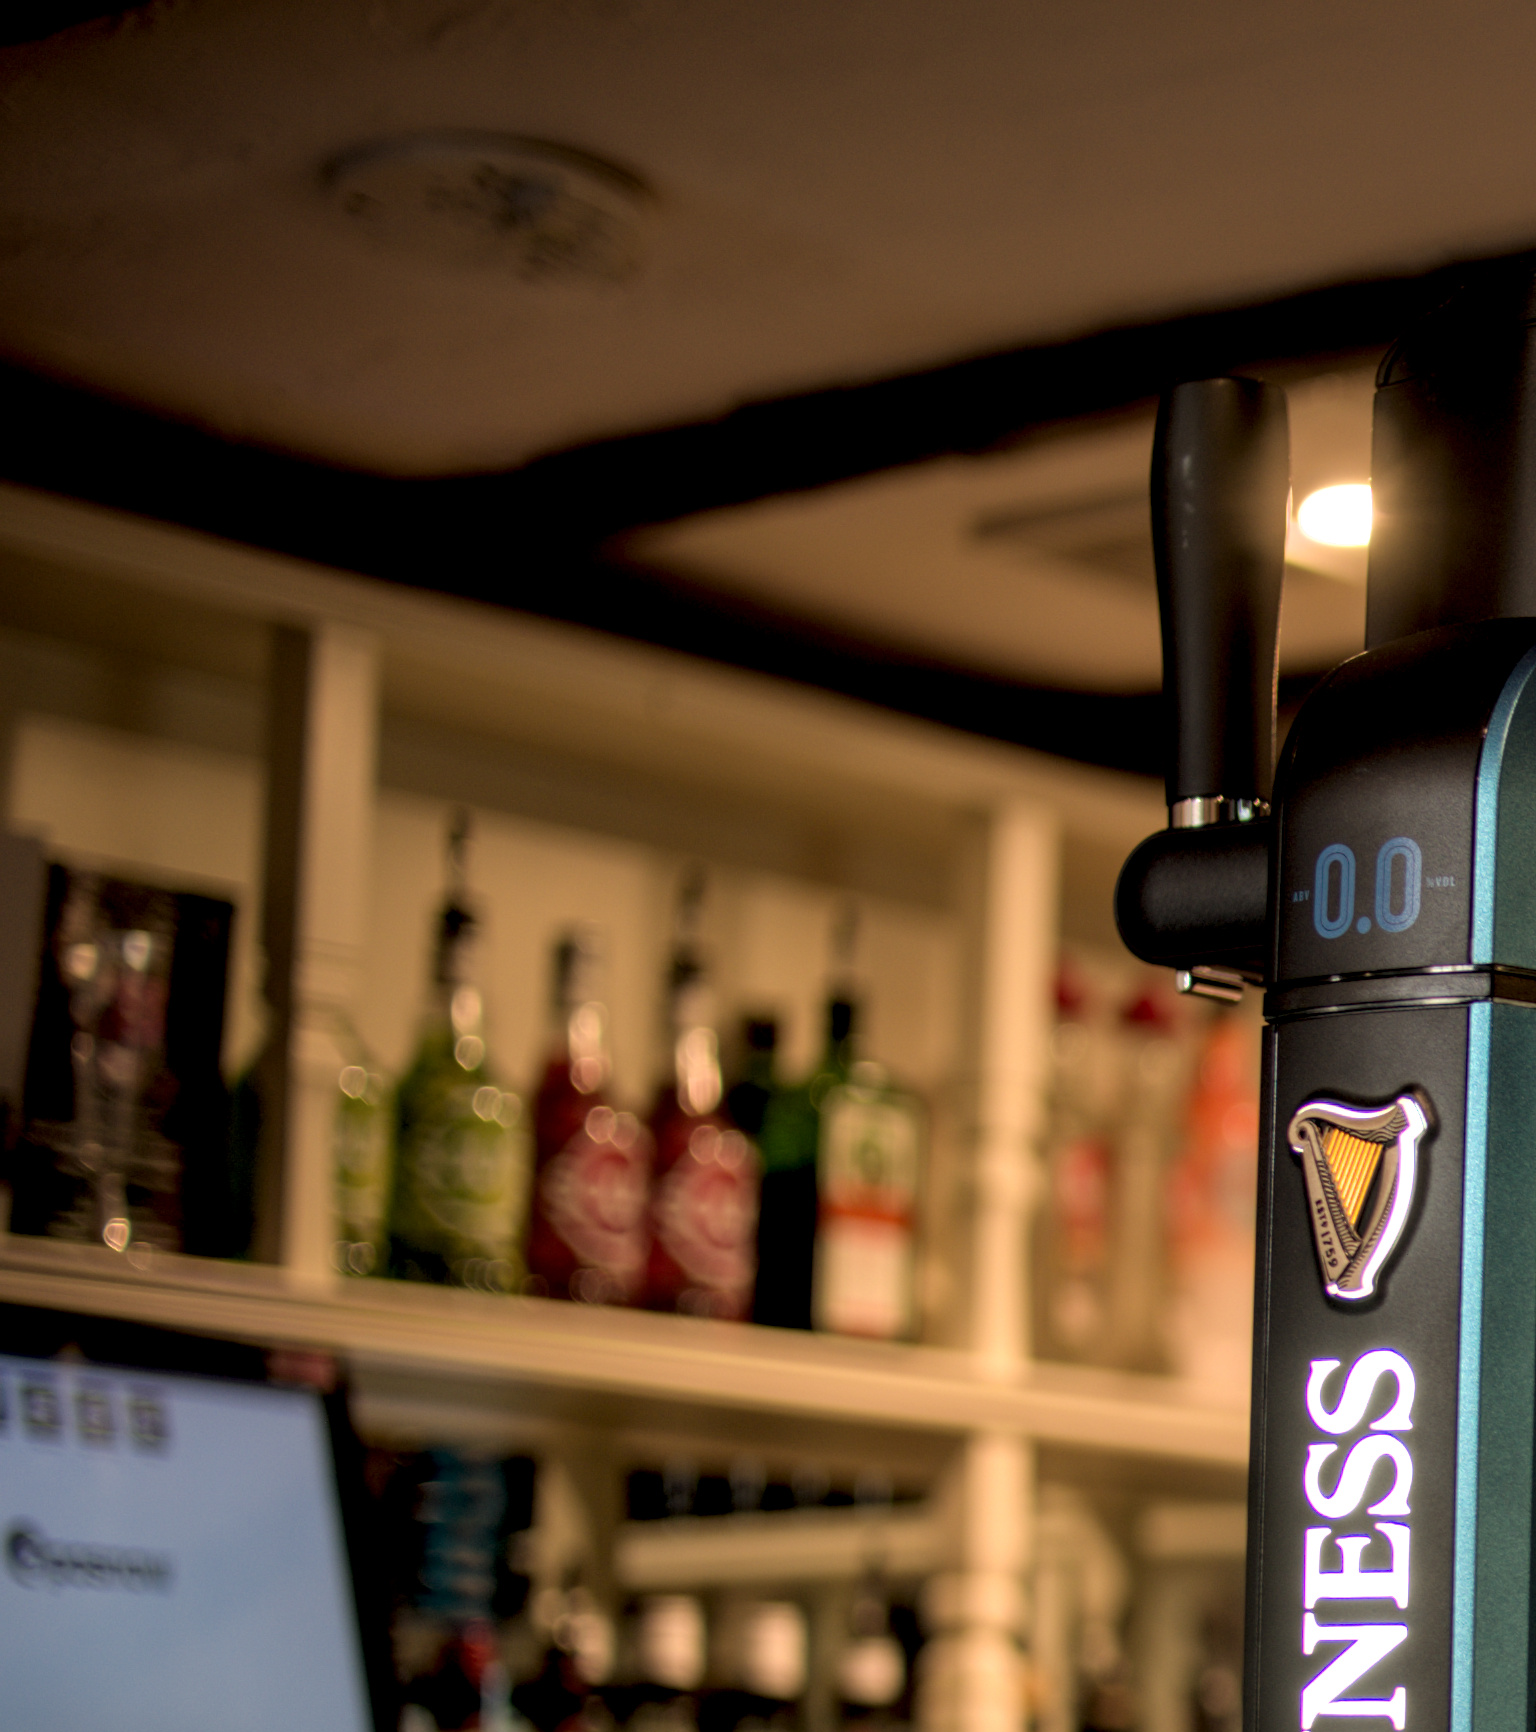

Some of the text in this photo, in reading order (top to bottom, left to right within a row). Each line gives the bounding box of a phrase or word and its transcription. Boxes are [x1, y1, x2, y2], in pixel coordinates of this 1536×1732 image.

[1292, 889, 1311, 904] ABV
[1313, 836, 1423, 940] 0.0
[1320, 1230, 1339, 1269] 1759
